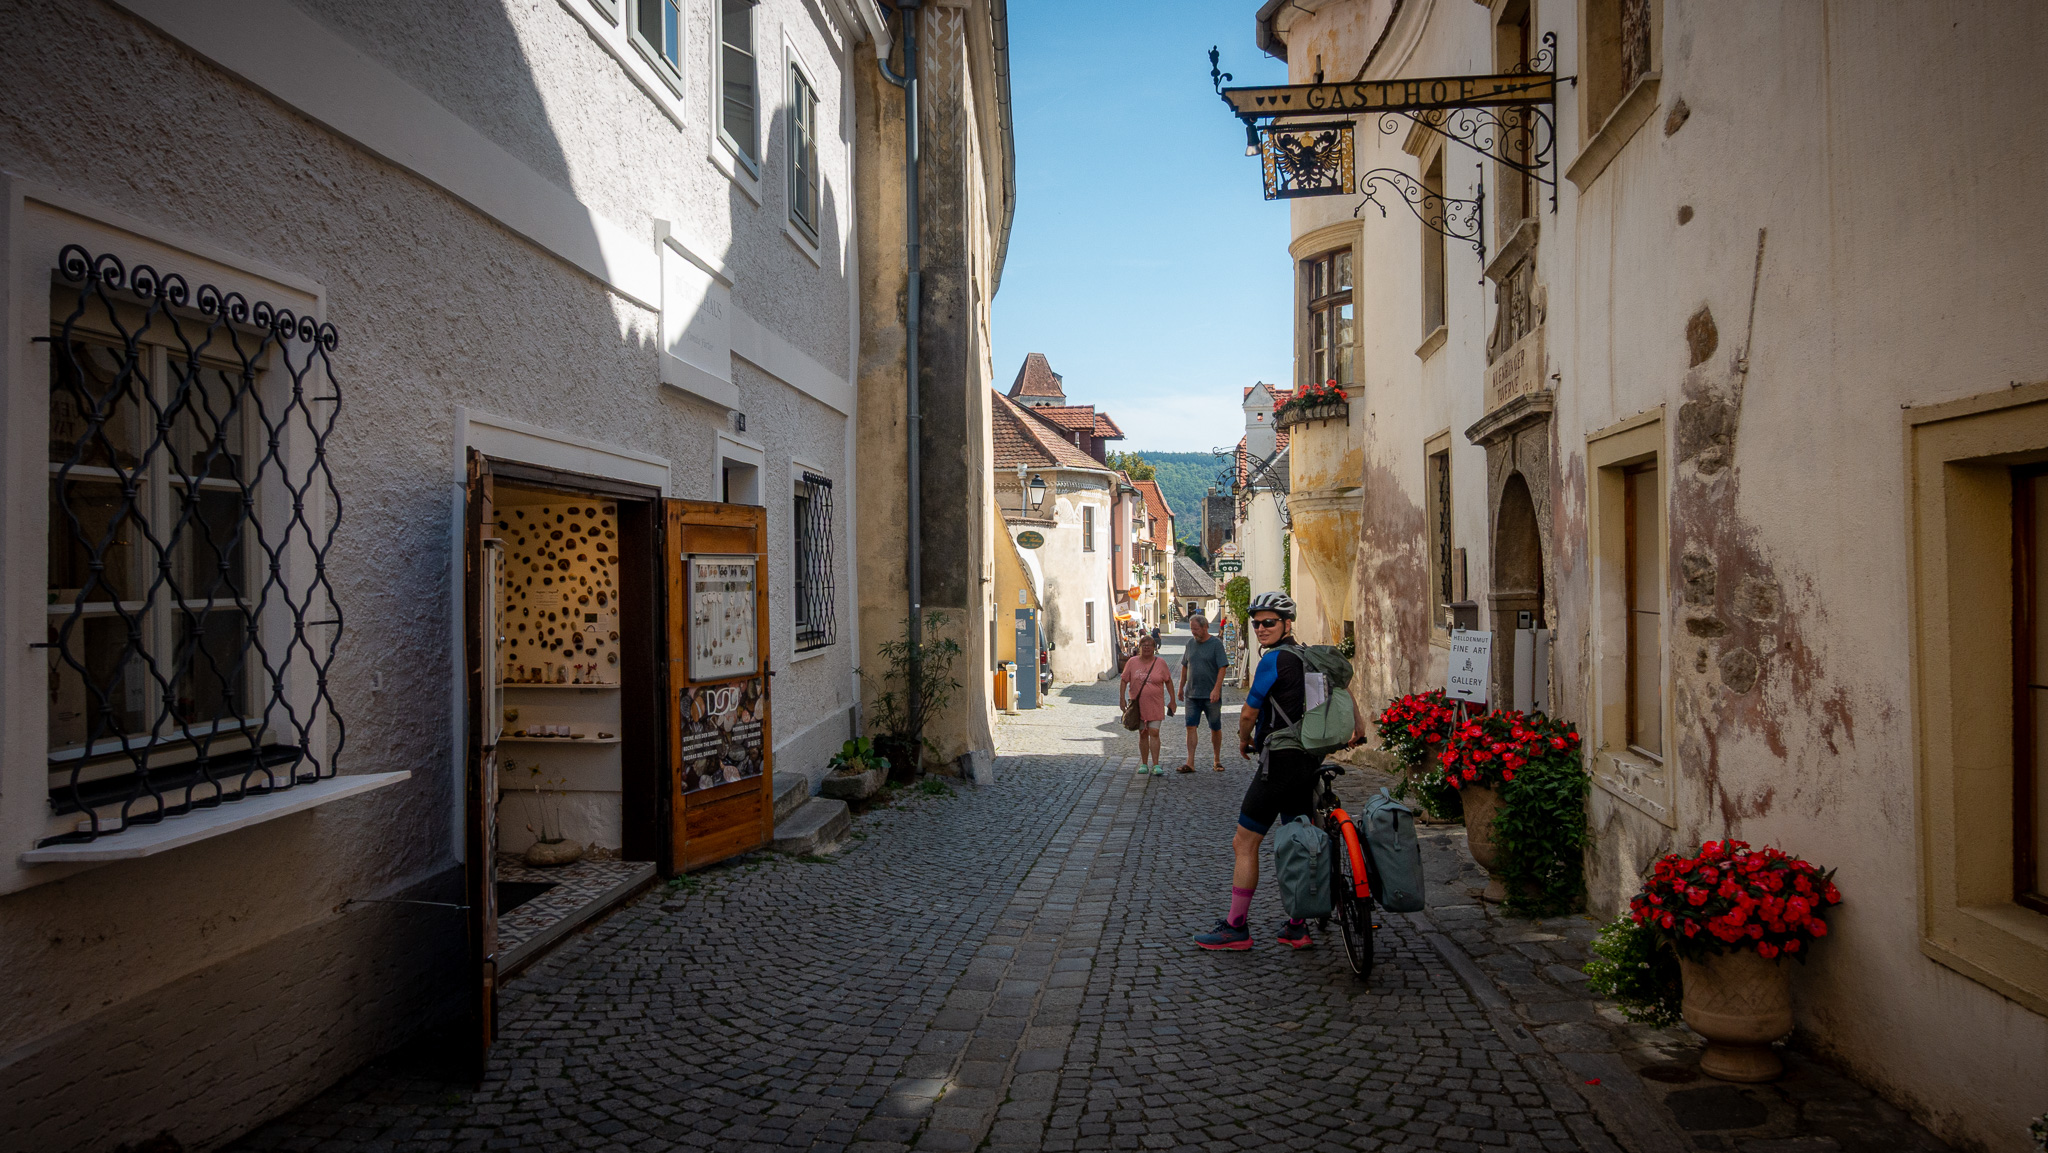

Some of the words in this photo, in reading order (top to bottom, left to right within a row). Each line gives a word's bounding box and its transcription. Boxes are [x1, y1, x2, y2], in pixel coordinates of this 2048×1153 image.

[1306, 80, 1476, 110] GASTHOF
[1497, 376, 1519, 405] TAVERNE
[1453, 635, 1489, 643] HELLDENMUT
[1453, 645, 1469, 653] FINE
[1472, 646, 1487, 655] ART
[1451, 675, 1483, 687] GALLERY
